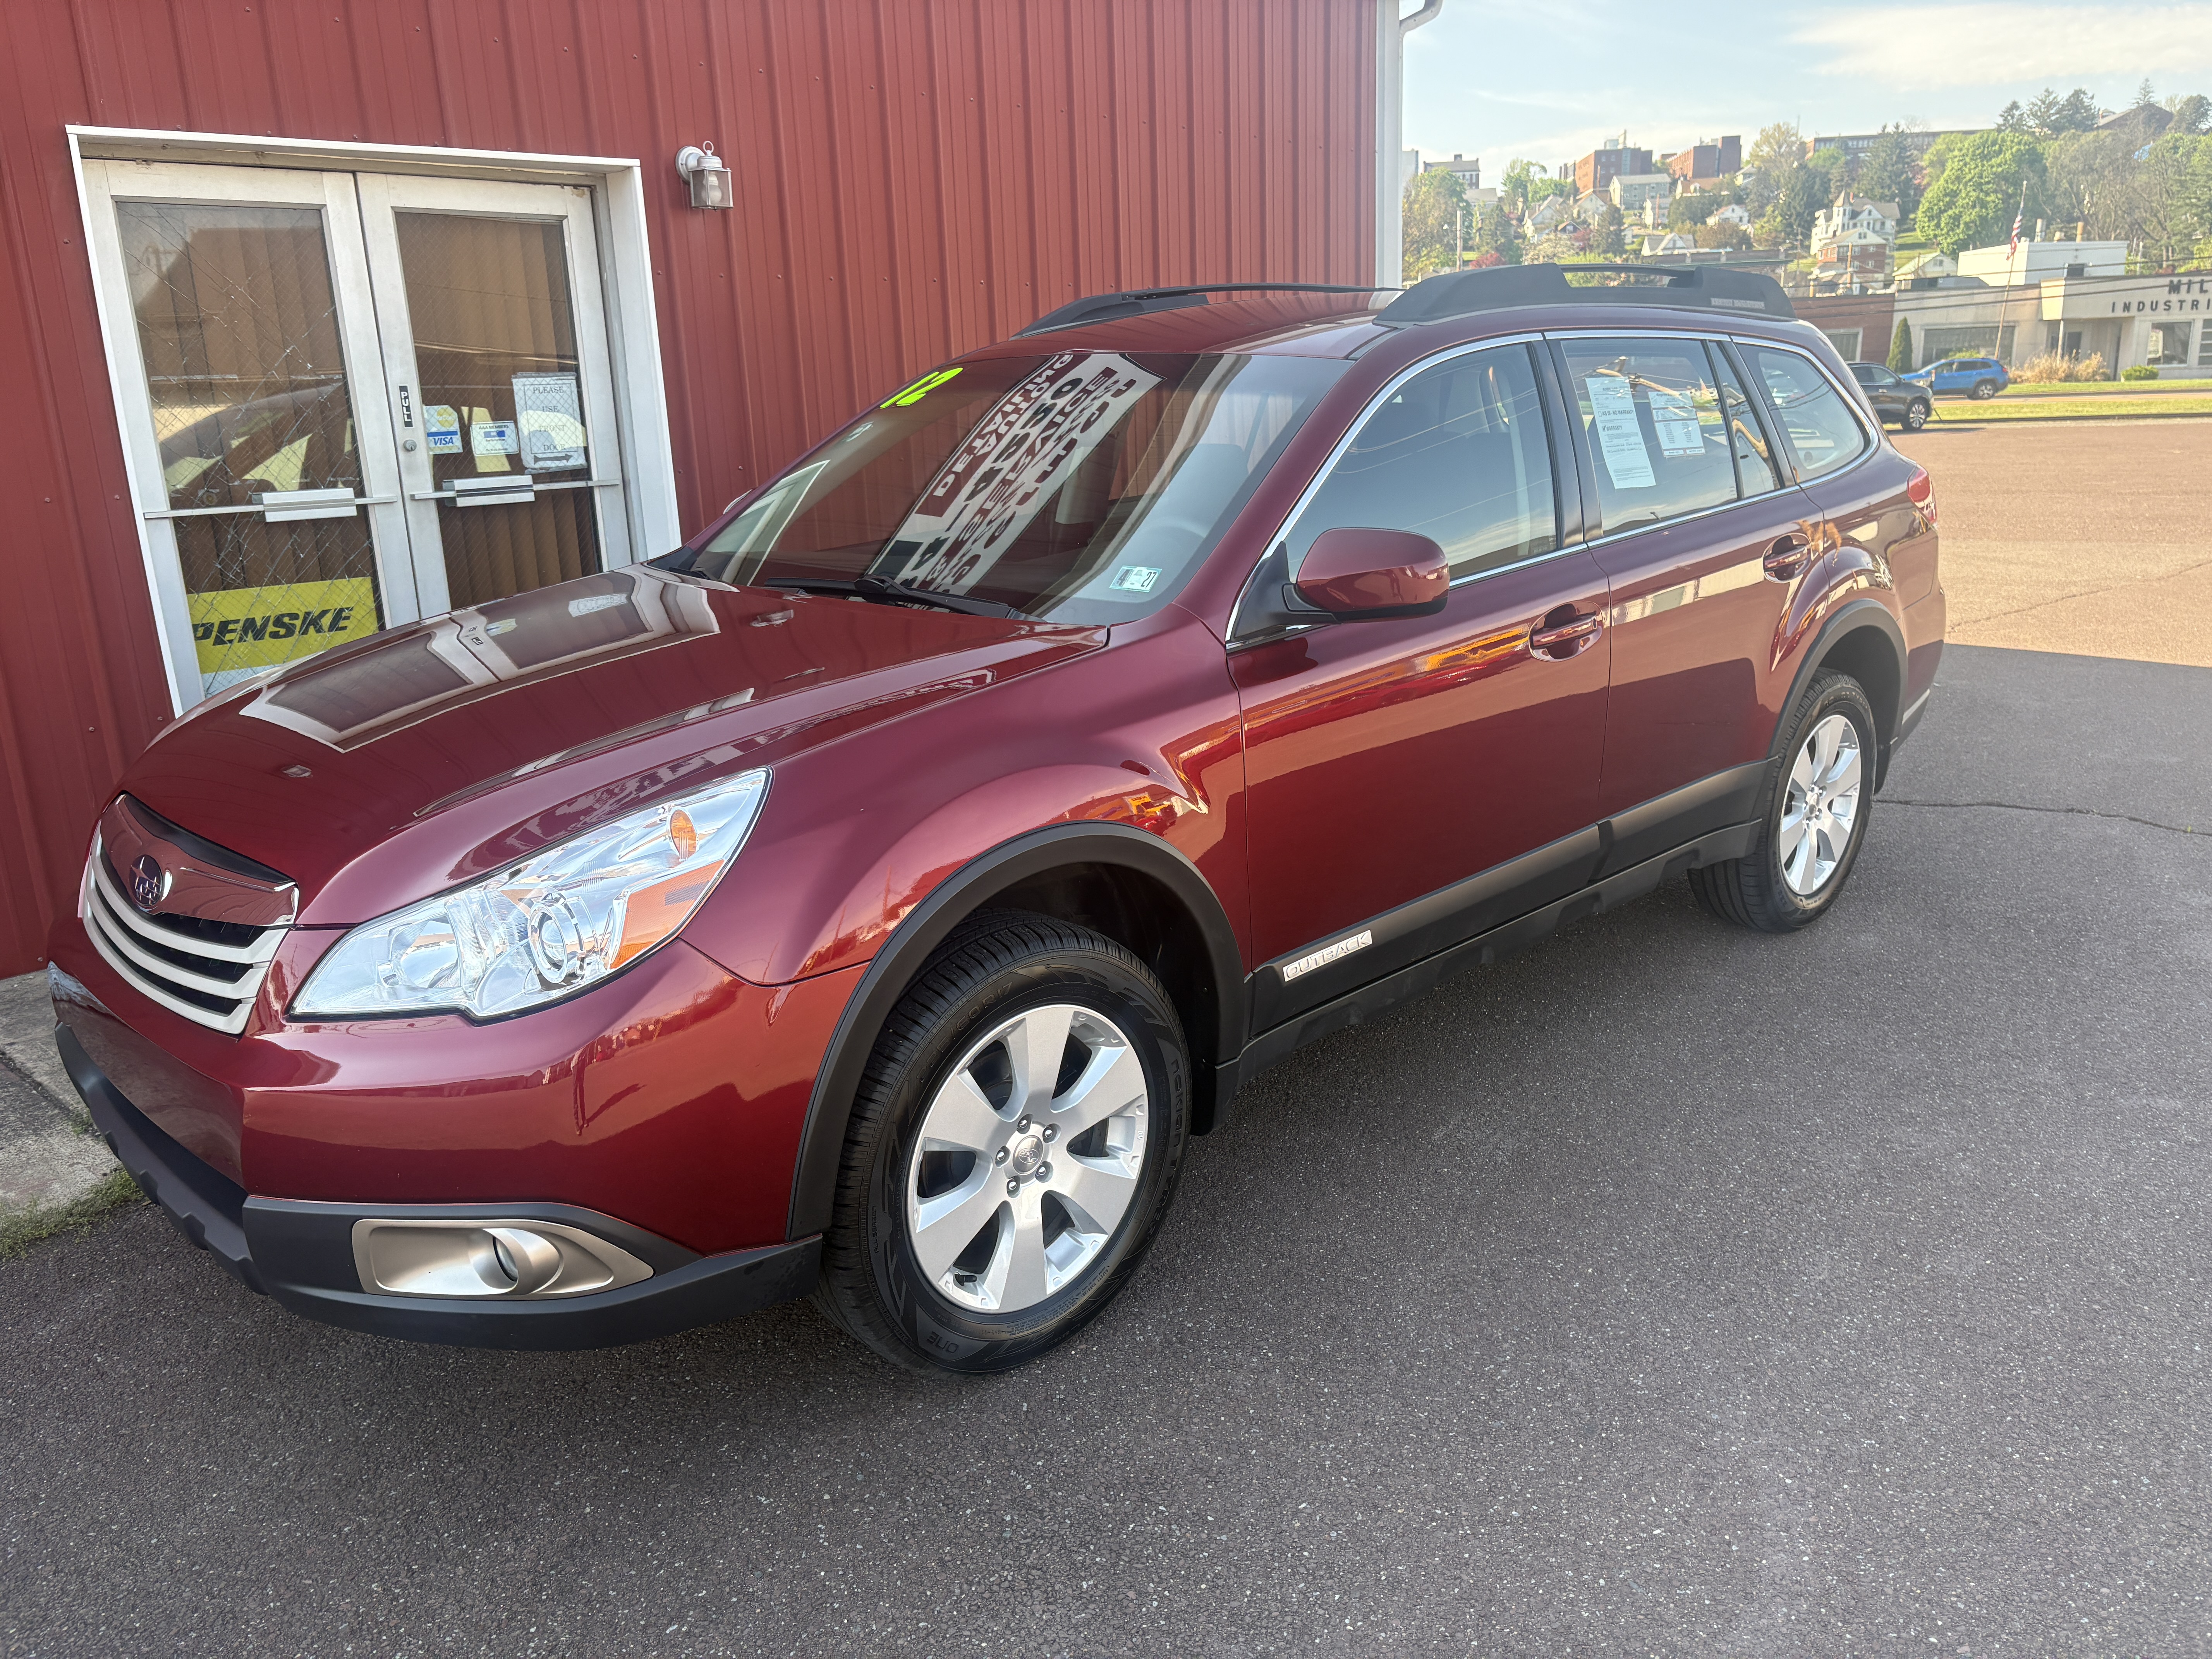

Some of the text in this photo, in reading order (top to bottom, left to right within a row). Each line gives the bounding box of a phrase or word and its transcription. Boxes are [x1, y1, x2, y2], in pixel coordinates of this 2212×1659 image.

[2168, 279, 2209, 294] MIL
[2112, 298, 2210, 313] INDUSTRI
[880, 368, 963, 409] 12
[400, 391, 412, 421] PULL
[433, 436, 454, 446] VISA
[1140, 572, 1158, 589] 27
[192, 607, 353, 646] PENSKE
[1285, 932, 1371, 979] OUTBACK
